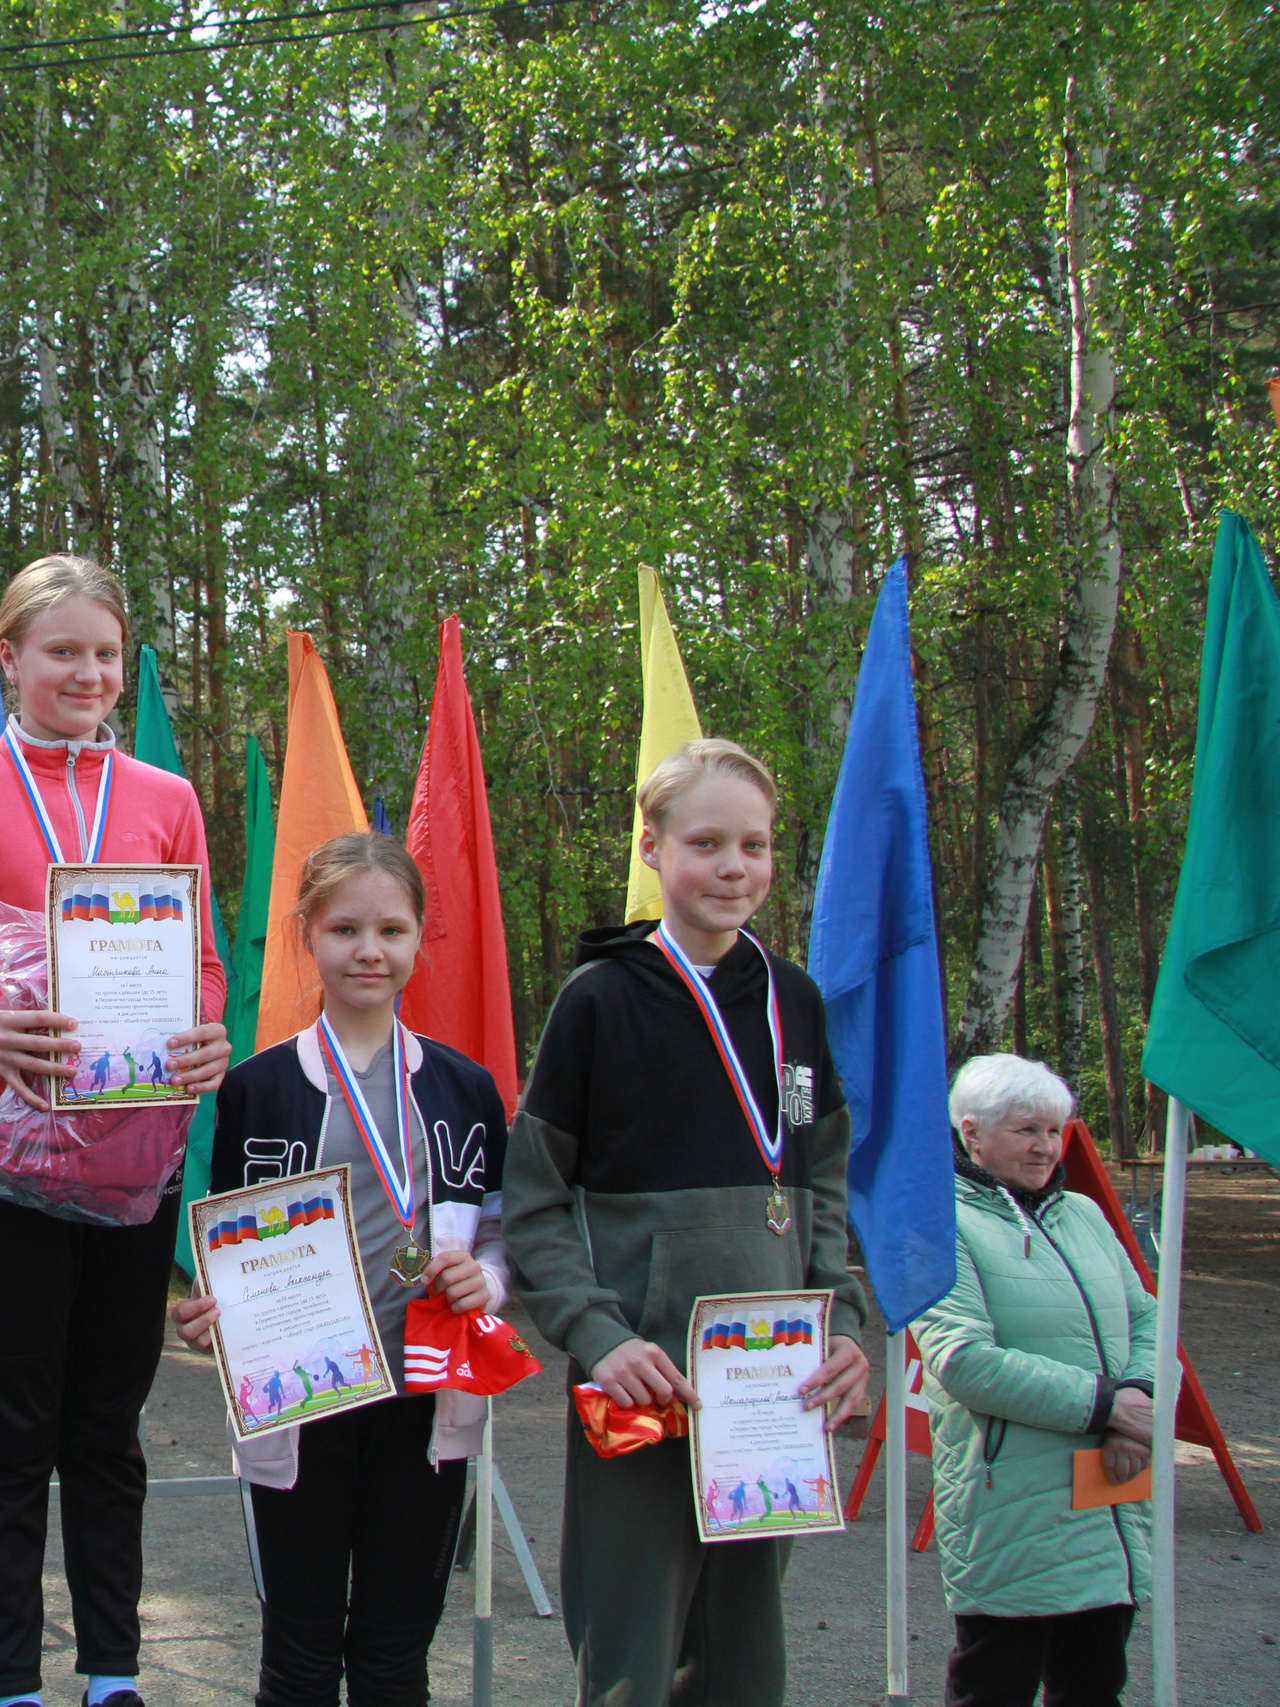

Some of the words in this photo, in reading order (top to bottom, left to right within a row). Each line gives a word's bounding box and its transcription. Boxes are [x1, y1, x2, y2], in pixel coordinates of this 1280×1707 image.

[90, 940, 163, 952] ГРАМОТА
[145, 965, 169, 975] Анна
[240, 1243, 316, 1274] ГРАМОТА
[264, 1264, 301, 1277] награждается
[259, 1313, 285, 1324] Первенстве
[286, 1308, 302, 1318] города
[302, 1299, 329, 1311] Челябинска
[260, 1308, 276, 1317] группе
[726, 1364, 792, 1380] ГРАМОТА
